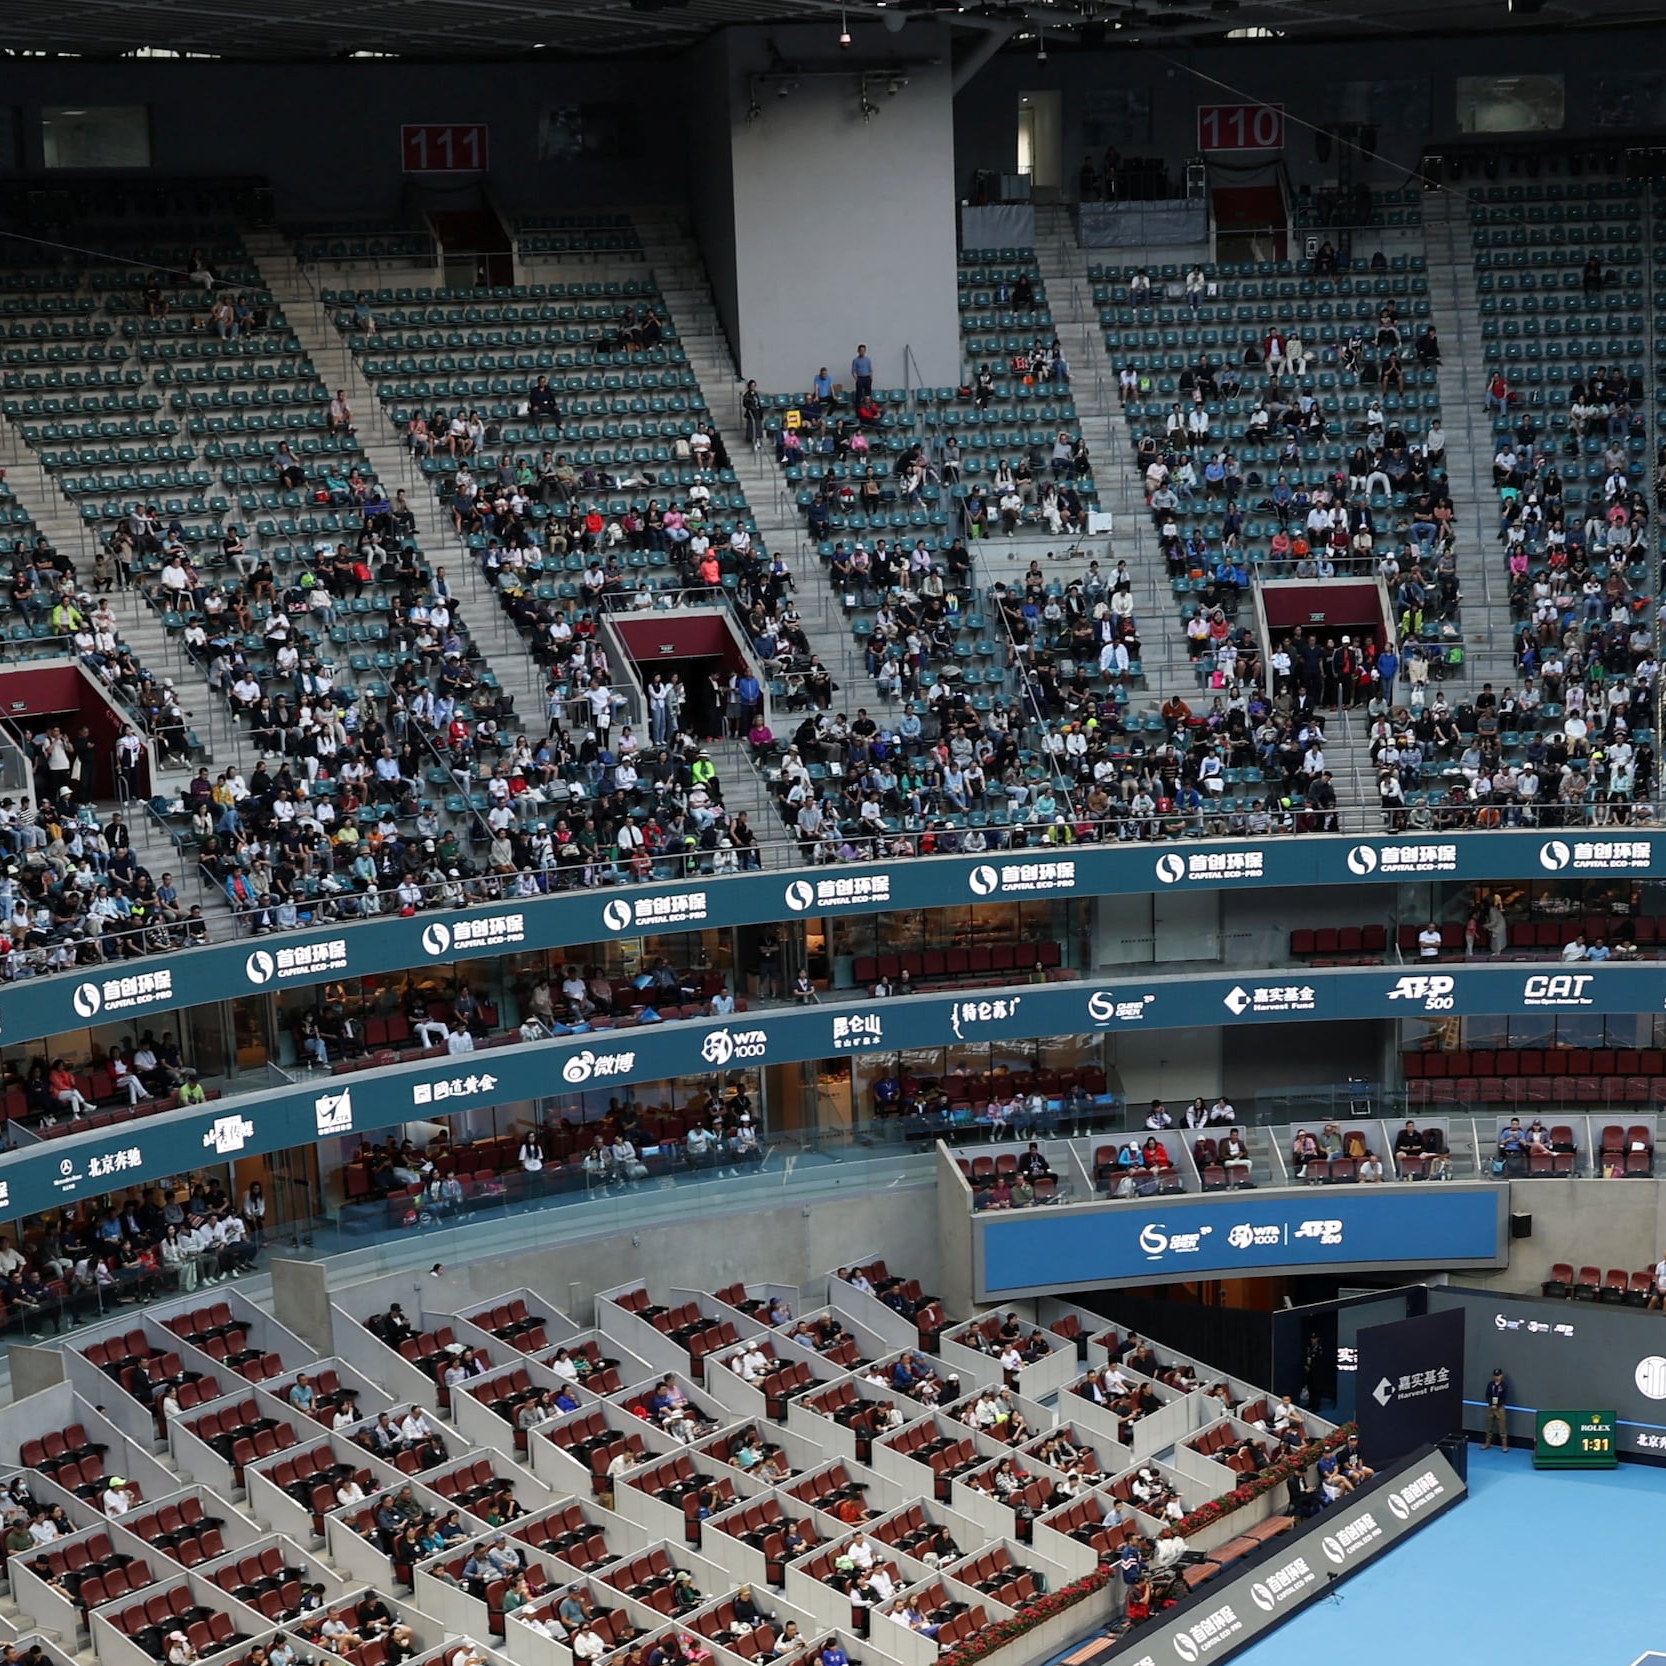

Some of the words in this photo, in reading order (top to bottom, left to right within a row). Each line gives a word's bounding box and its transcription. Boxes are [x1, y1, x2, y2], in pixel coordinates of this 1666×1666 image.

[410, 127, 480, 169] 111
[1202, 107, 1280, 167] 110
[1188, 852, 1264, 872] 首创环保
[1381, 845, 1457, 864] 首创环保
[1574, 842, 1651, 860] 首创环保
[1001, 862, 1076, 884] 首创环保
[817, 875, 890, 899] 首创环保
[634, 892, 707, 918] 首创环保
[452, 914, 524, 941] 首创环保
[276, 940, 347, 969] 首创环保
[102, 970, 172, 1002] 首创环保
[1253, 986, 1316, 1003] 嘉实基金
[1386, 975, 1455, 1000] ATP
[1523, 975, 1595, 998] CAT
[962, 999, 1008, 1023] 特仑苏
[1424, 996, 1455, 1011] 500
[733, 1030, 768, 1048] WTA
[833, 1014, 884, 1041] 昆仑山
[734, 1043, 766, 1059] 1000
[593, 1051, 636, 1078] 微博
[87, 1147, 142, 1179] 北京奔驰
[1252, 1225, 1281, 1237] WTA
[1253, 1235, 1279, 1245] 1000
[1293, 1219, 1344, 1238] ATP
[1320, 1234, 1344, 1245] 500
[1398, 1366, 1451, 1391] 嘉实基金
[1579, 1423, 1613, 1433] ROLEX
[1581, 1437, 1611, 1452] 1:31
[1400, 1471, 1440, 1505] 首创环保
[1335, 1512, 1379, 1548] 首创环保
[1265, 1557, 1311, 1594] 首创环保
[1189, 1604, 1238, 1644] 首创环保
